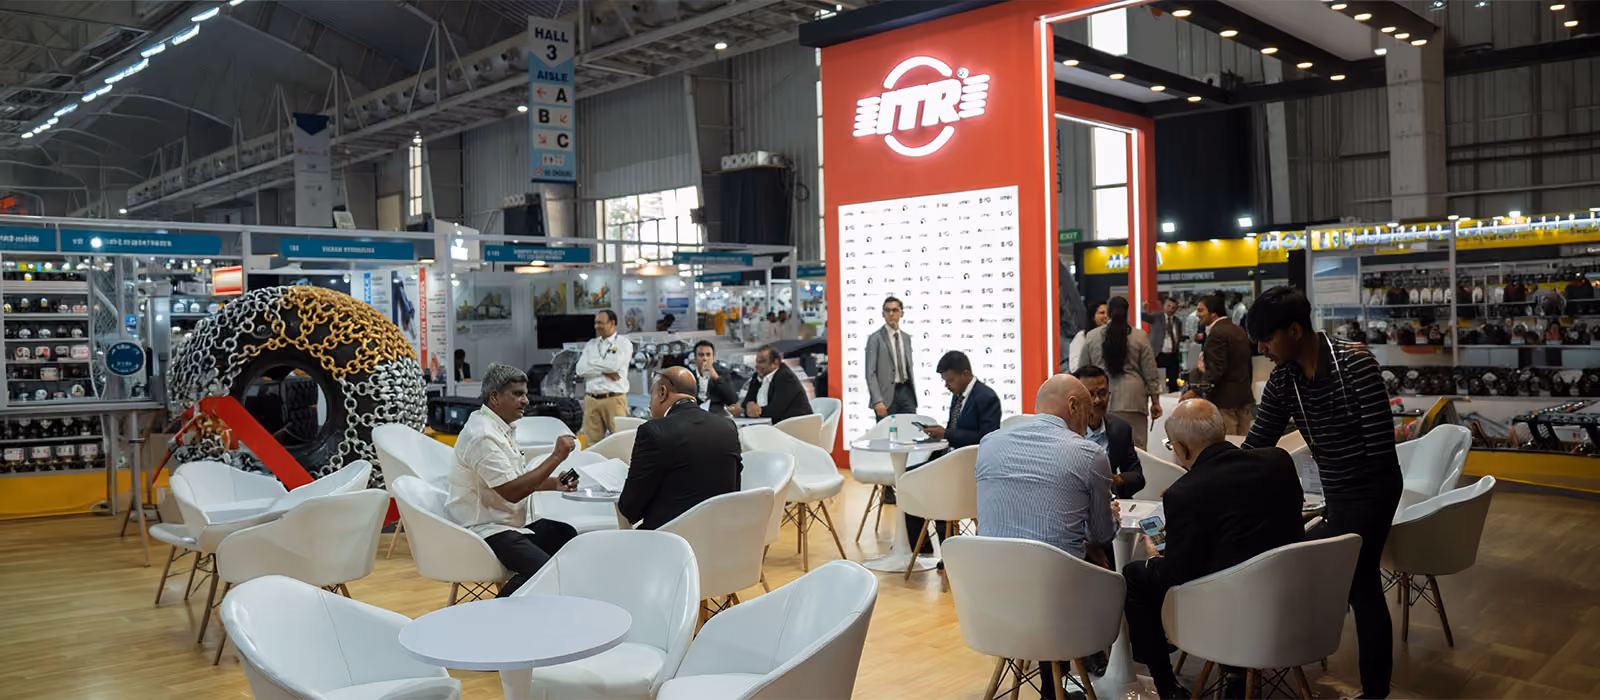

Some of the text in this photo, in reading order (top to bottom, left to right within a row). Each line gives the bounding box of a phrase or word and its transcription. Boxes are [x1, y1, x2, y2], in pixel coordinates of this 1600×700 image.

[534, 26, 569, 43] HALL
[546, 44, 558, 61] 3
[536, 70, 569, 82] AISLE
[555, 87, 568, 103] A
[876, 78, 962, 135] ITR
[538, 108, 550, 124] B
[556, 133, 569, 149] C
[1059, 231, 1079, 241] EXIT
[1181, 271, 1215, 281] COMPONENTS
